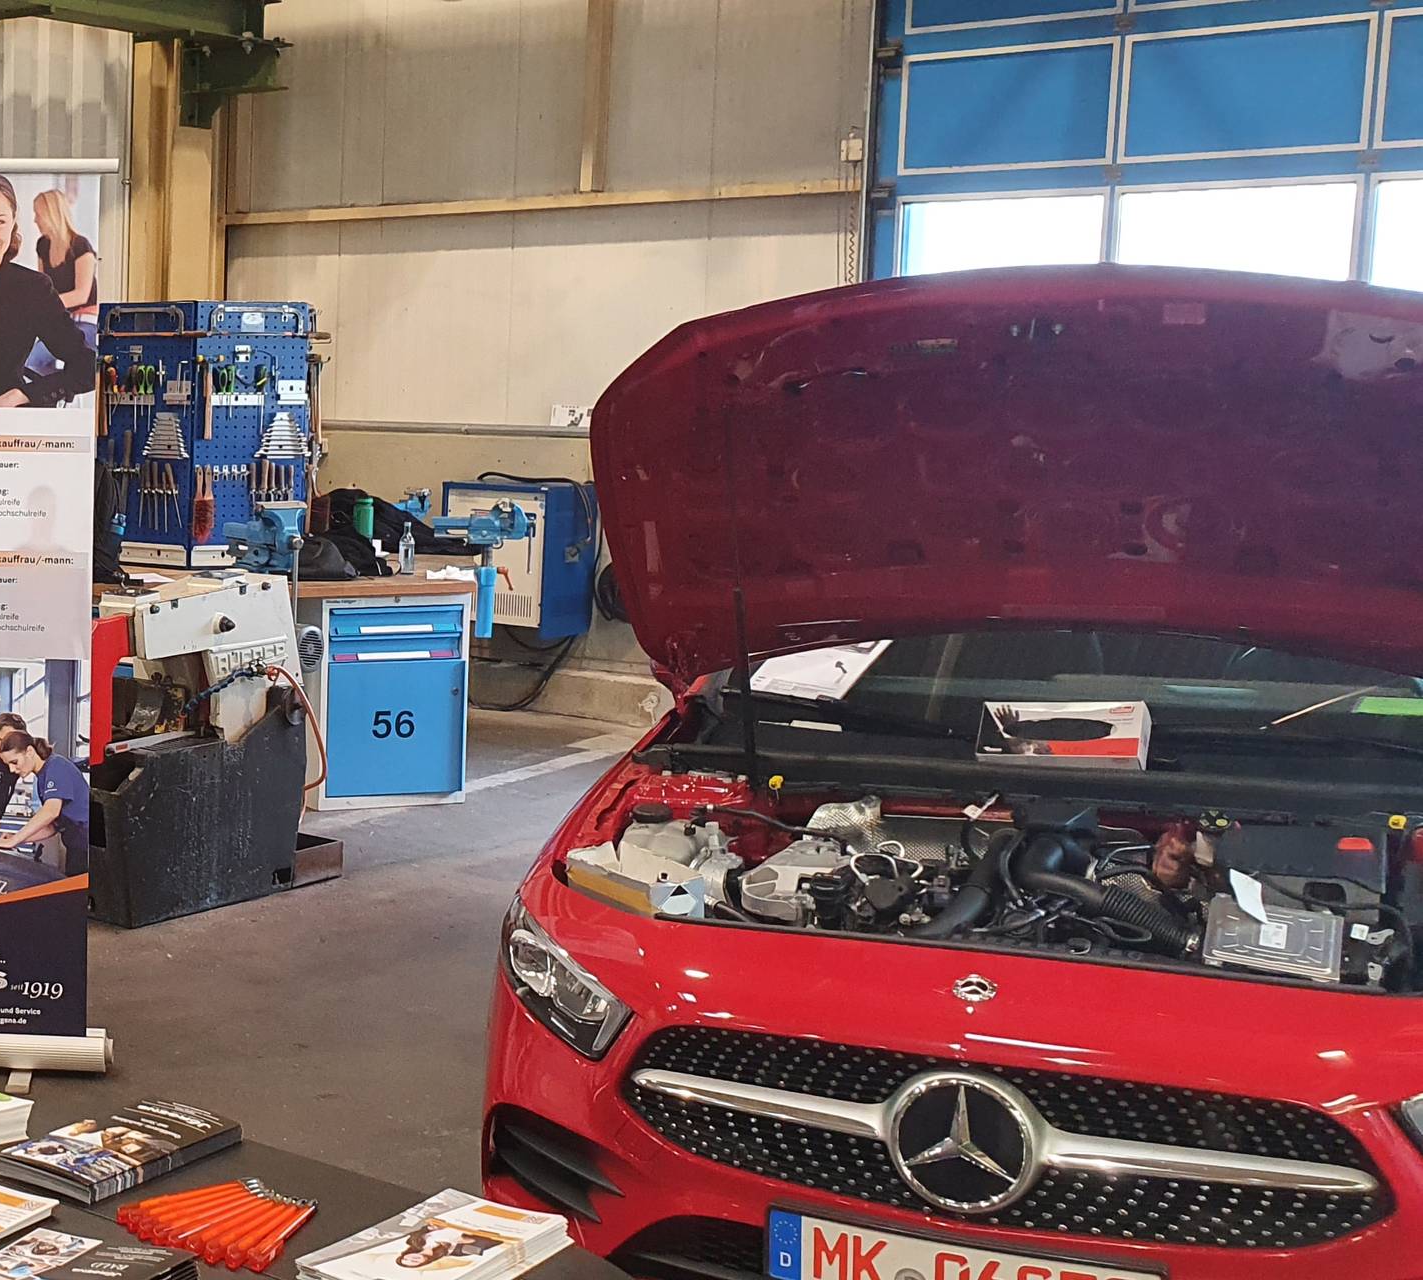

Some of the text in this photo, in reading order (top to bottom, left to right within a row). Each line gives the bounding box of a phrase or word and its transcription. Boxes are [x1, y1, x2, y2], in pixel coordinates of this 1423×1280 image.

[372, 710, 415, 738] 56
[22, 982, 63, 1000] 1919
[15, 1007, 41, 1015] Service
[780, 1251, 792, 1267] D
[813, 1227, 888, 1280] MK
